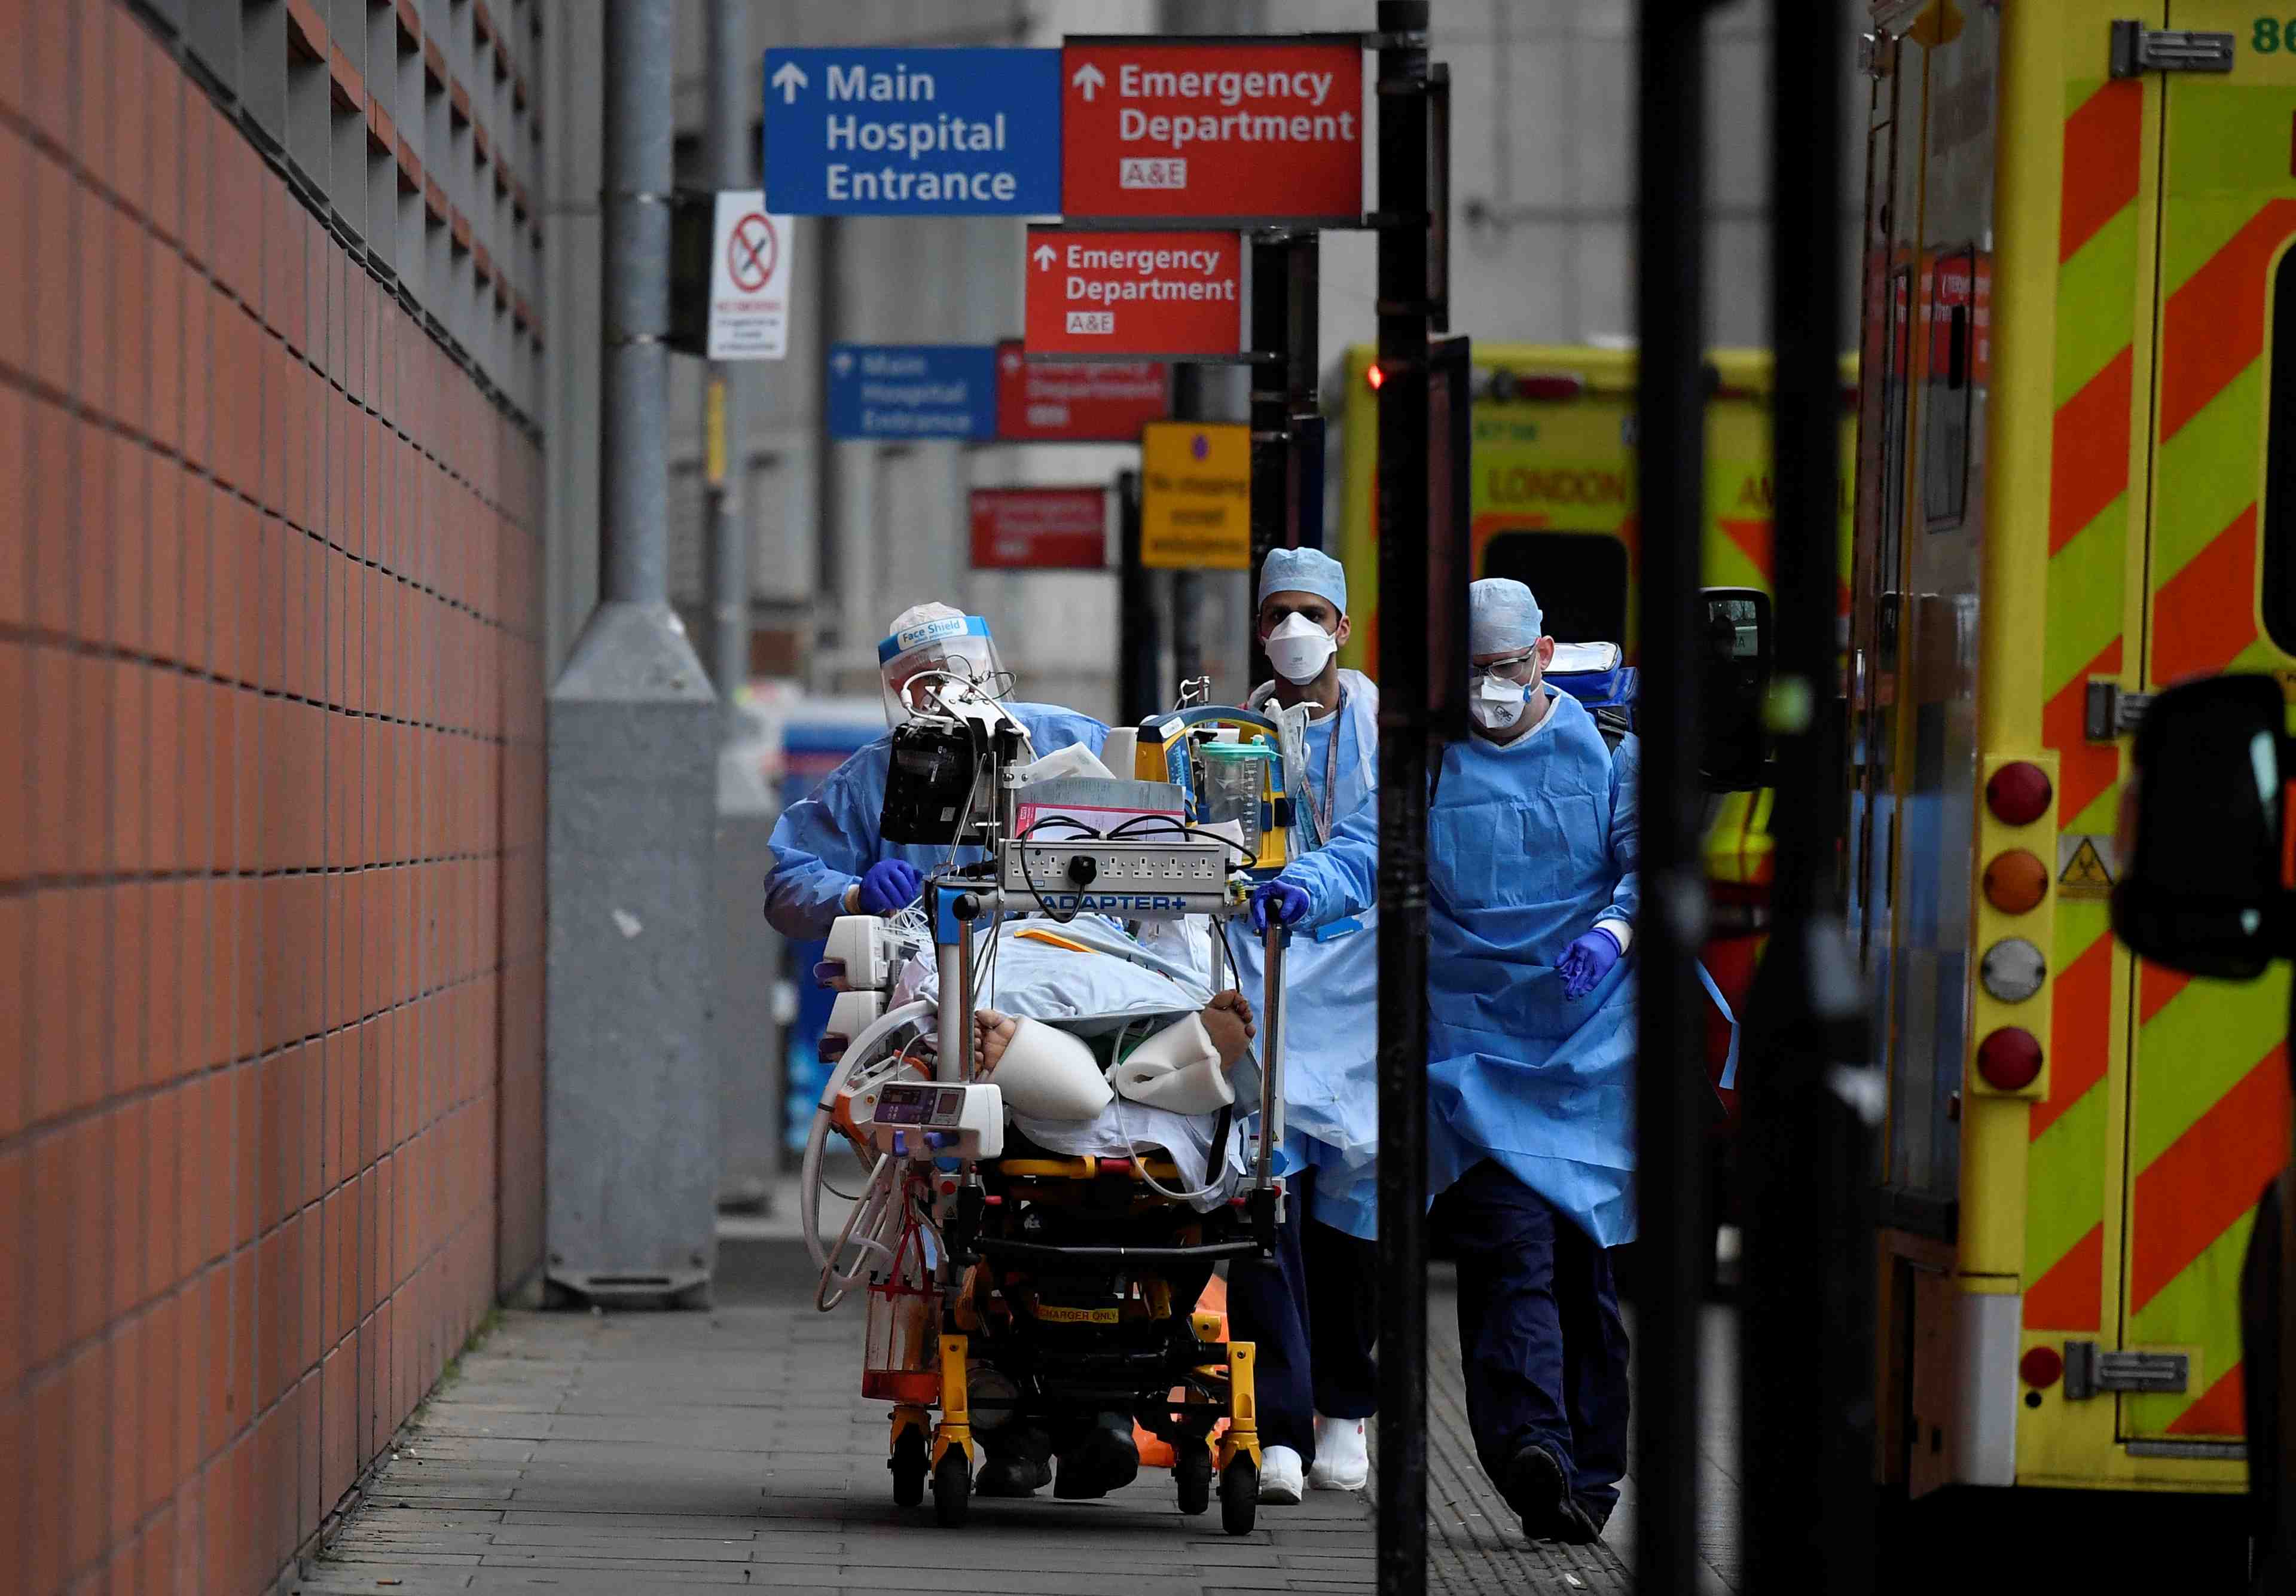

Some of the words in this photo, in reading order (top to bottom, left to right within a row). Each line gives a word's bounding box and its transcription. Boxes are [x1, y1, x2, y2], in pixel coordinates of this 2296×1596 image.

[826, 64, 936, 101] Main
[1119, 64, 1334, 106] Emergency
[826, 113, 1006, 160] Hospital
[1119, 108, 1355, 149] Department
[826, 163, 1016, 201] Entrance
[1125, 162, 1184, 184] A&E
[1067, 244, 1220, 275] Emergency
[1067, 276, 1235, 305] Department
[1070, 314, 1112, 331] A&E
[1489, 468, 1627, 505] LONDON
[903, 629, 925, 643] Face
[927, 619, 960, 634] Shield
[1040, 895, 1187, 910] ADAPTER+
[1092, 1311, 1117, 1320] ONLY
